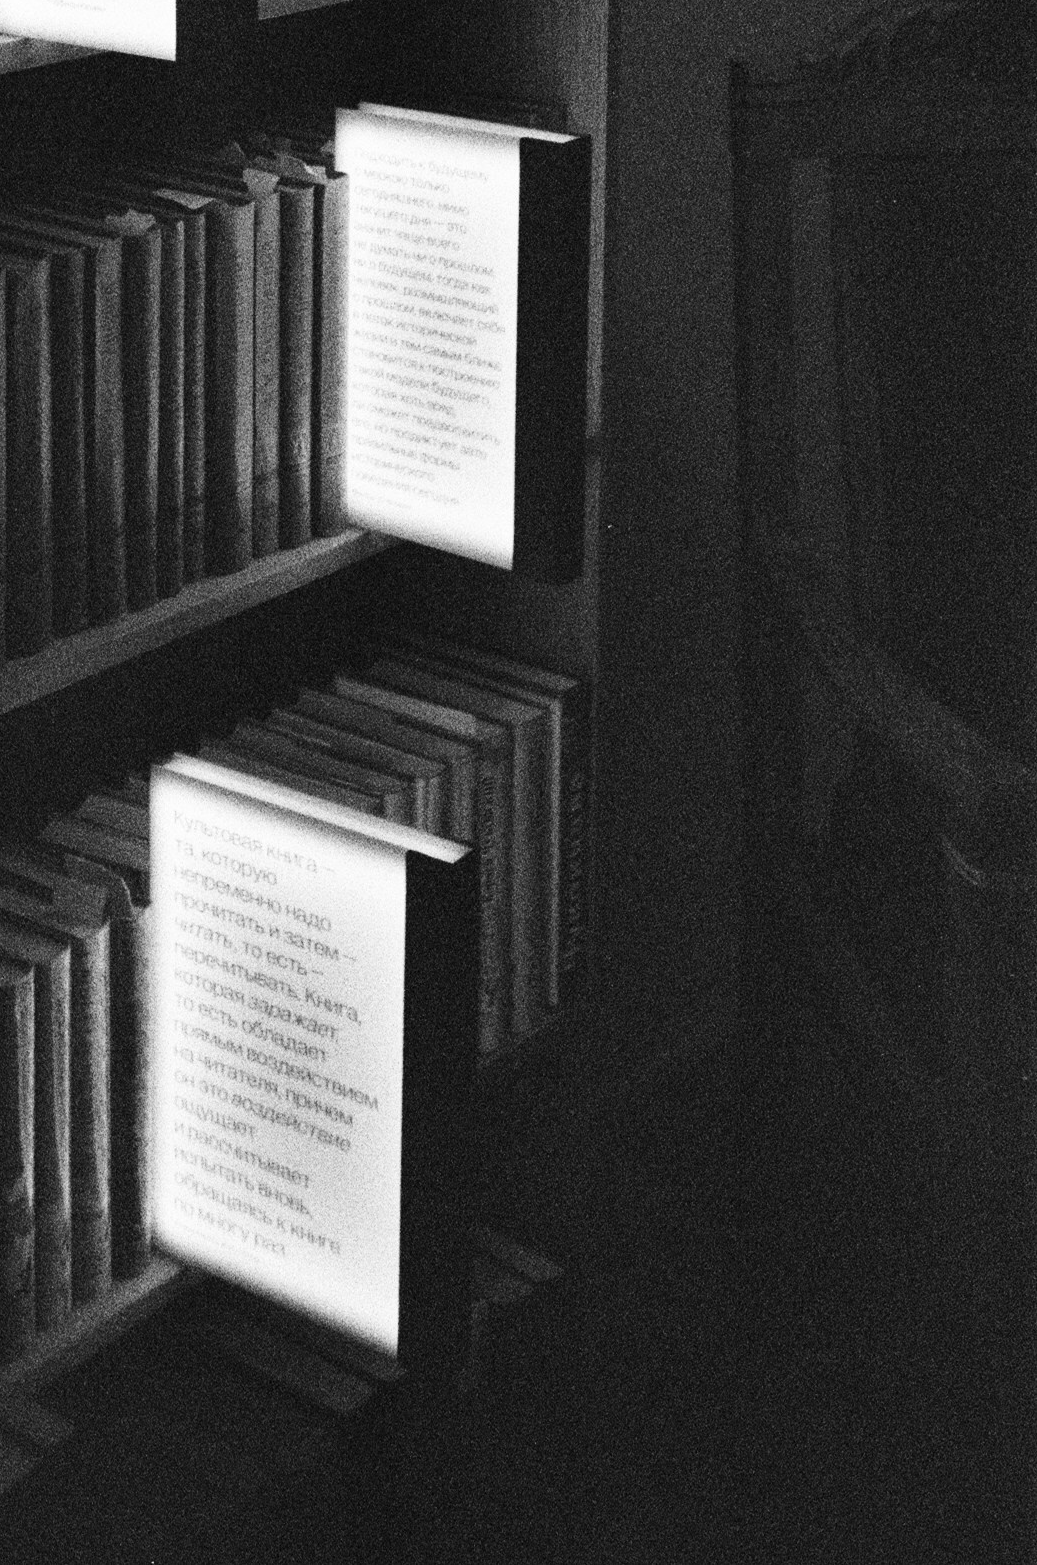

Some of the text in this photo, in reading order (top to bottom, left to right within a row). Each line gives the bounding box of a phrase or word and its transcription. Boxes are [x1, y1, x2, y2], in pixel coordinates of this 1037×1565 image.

[173, 809, 318, 874] Культовая книга
[202, 847, 278, 889] которую
[173, 864, 332, 935] непременно надо
[173, 890, 264, 938] прочитать
[283, 929, 339, 962] затем
[173, 966, 244, 1008] которая
[242, 940, 261, 960] то
[266, 948, 307, 977] есть
[173, 1043, 193, 1064] на
[174, 992, 326, 1066] то есть обладает
[173, 1018, 378, 1113] прямым воздействием
[173, 1067, 350, 1156] он это воздействие
[173, 1093, 255, 1142] ощущает
[187, 1125, 309, 1192] рассчитывает
